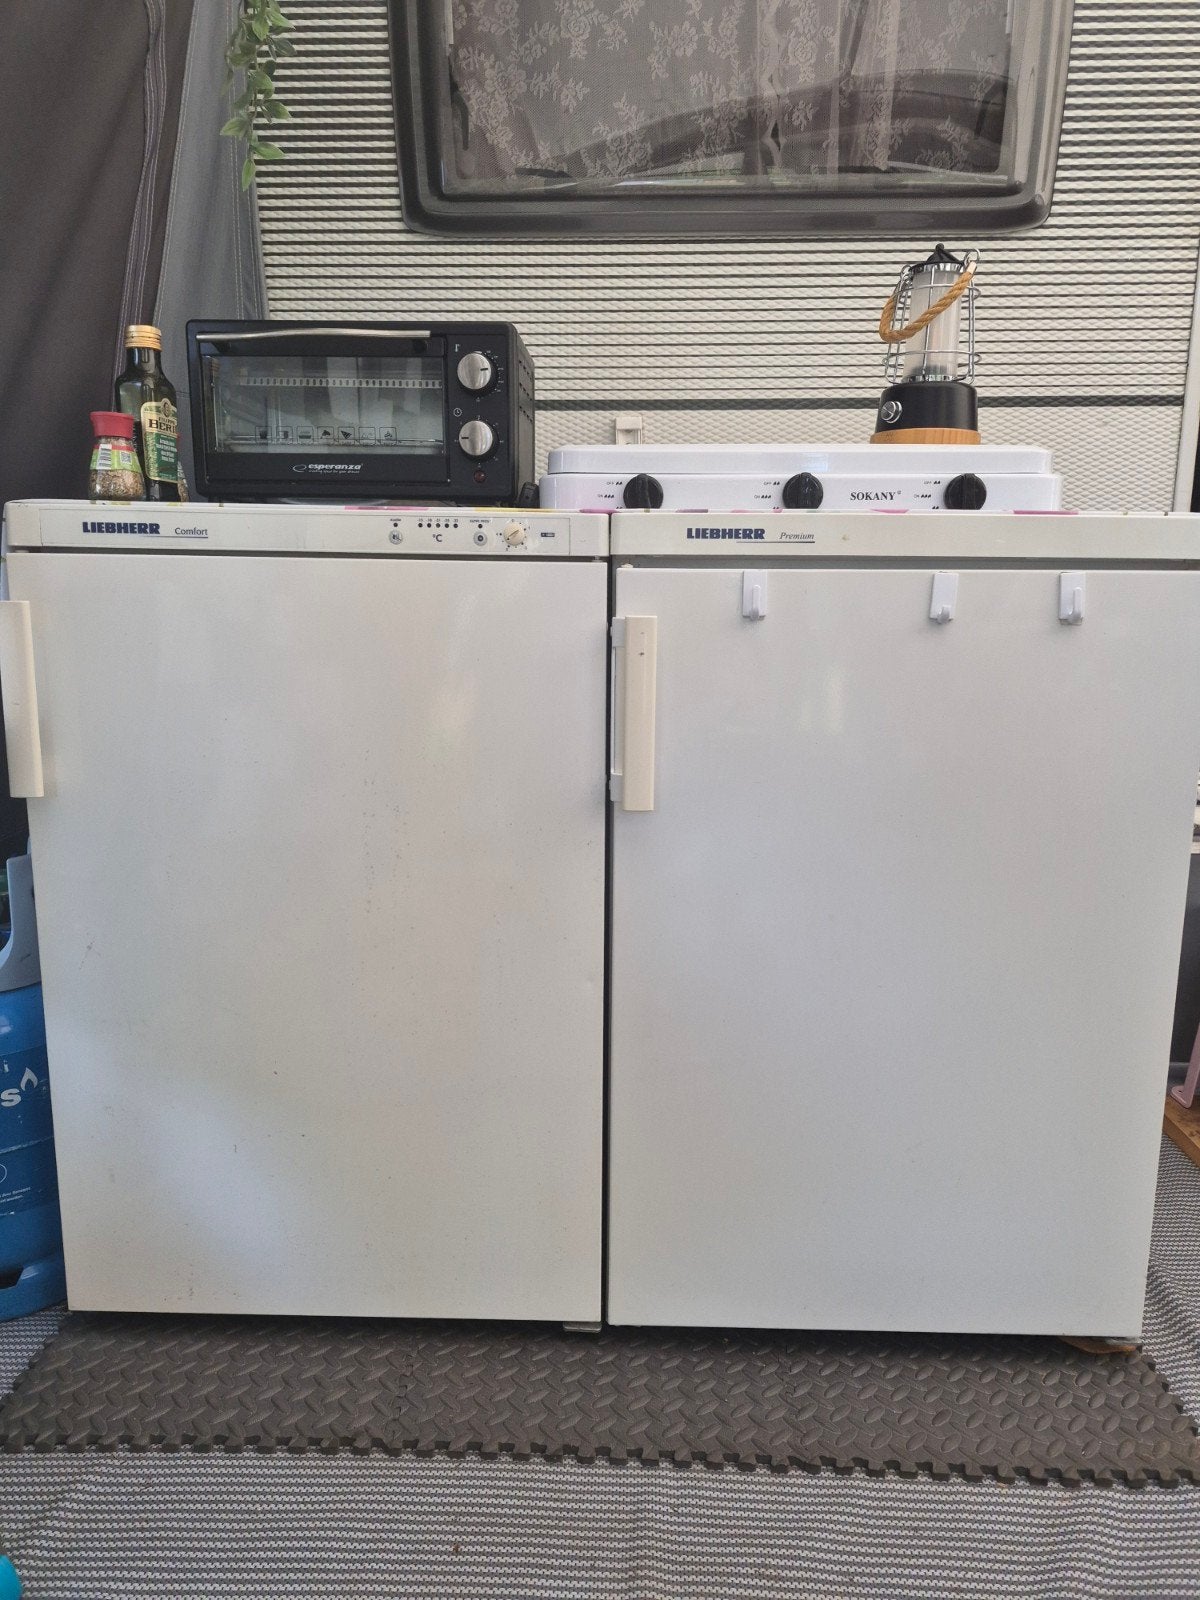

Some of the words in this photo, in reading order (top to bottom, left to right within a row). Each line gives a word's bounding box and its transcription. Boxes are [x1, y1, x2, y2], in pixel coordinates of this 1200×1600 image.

[850, 491, 896, 501] SOKANY
[82, 521, 161, 535] LIEBHERR
[174, 526, 209, 536] Comfort
[686, 527, 766, 540] LIEBHERR
[779, 531, 816, 541] Premium
